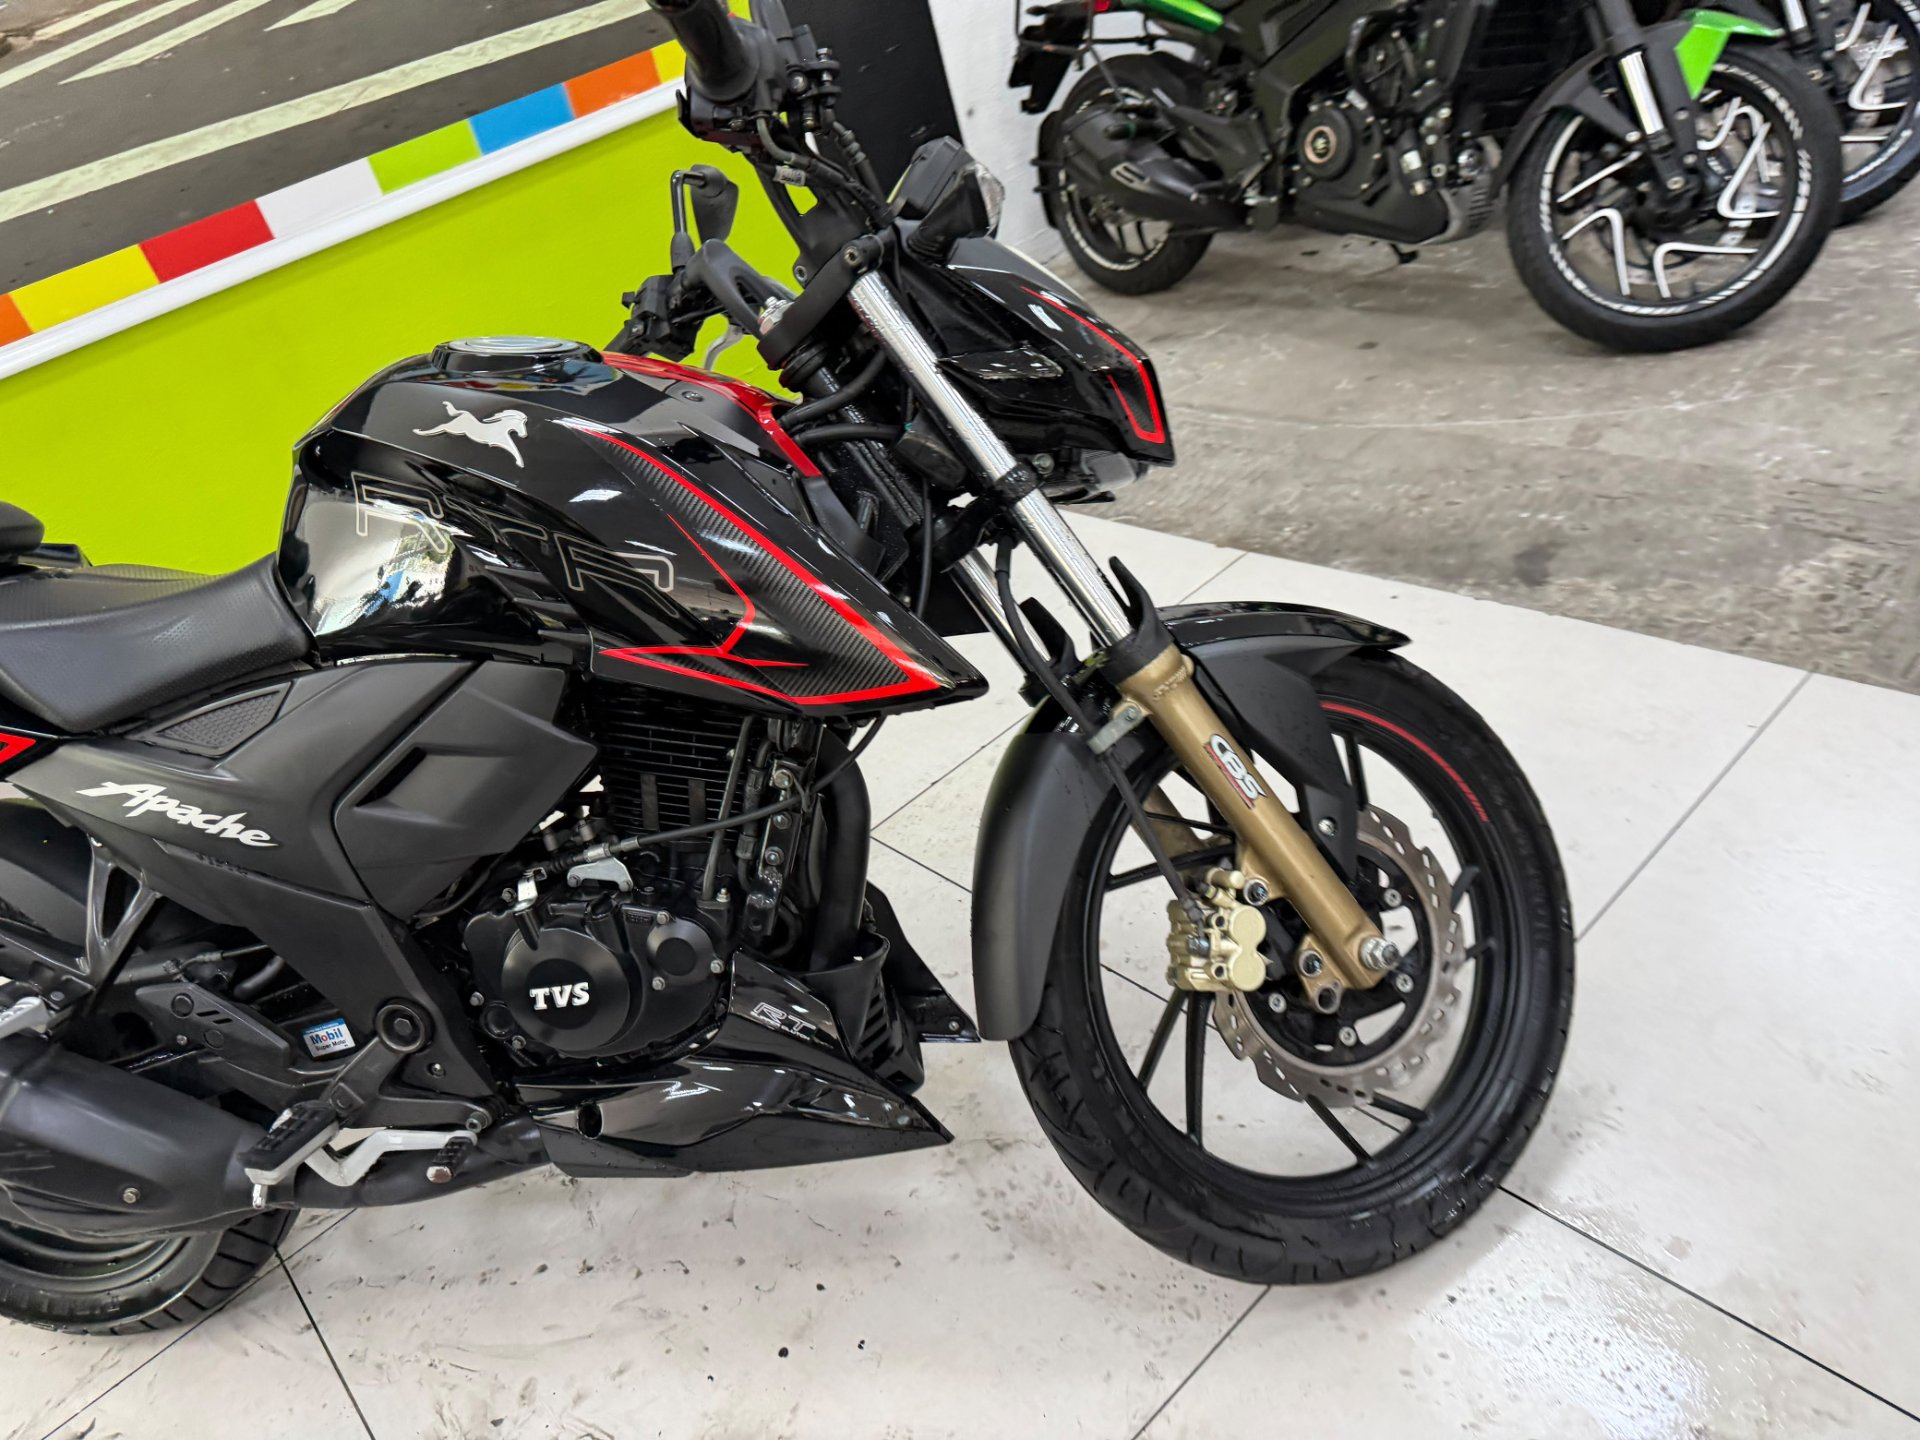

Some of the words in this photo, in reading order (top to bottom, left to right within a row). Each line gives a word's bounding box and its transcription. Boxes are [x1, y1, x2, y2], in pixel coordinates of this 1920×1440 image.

[76, 781, 279, 847] Apache
[529, 981, 590, 1011] TVS
[753, 1002, 817, 1032] RT
[309, 1028, 343, 1045] Mobil
